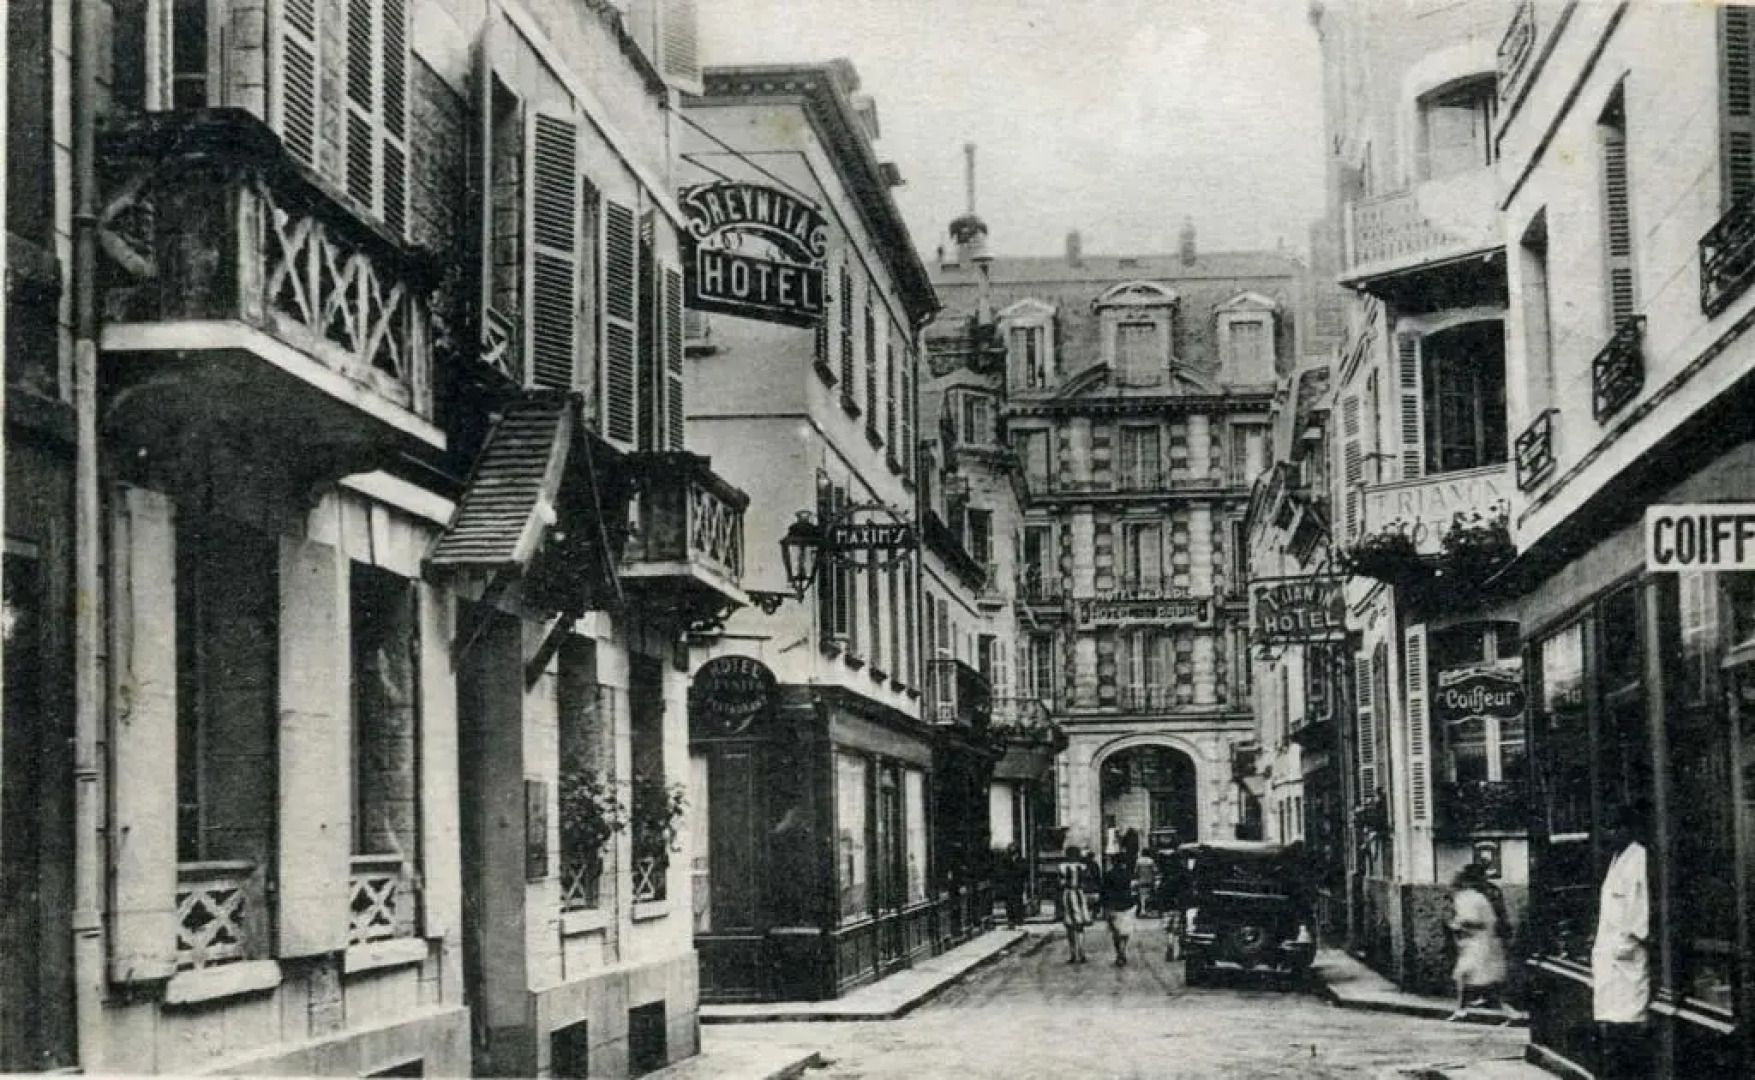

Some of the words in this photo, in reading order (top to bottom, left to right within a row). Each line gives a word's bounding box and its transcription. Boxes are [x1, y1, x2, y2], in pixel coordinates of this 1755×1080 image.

[704, 253, 818, 309] HOTEL
[835, 528, 907, 545] MAXIM'S
[1653, 515, 1755, 565] COIFF
[1264, 608, 1341, 633] HOTEL
[1446, 685, 1516, 713] Coiffeur
